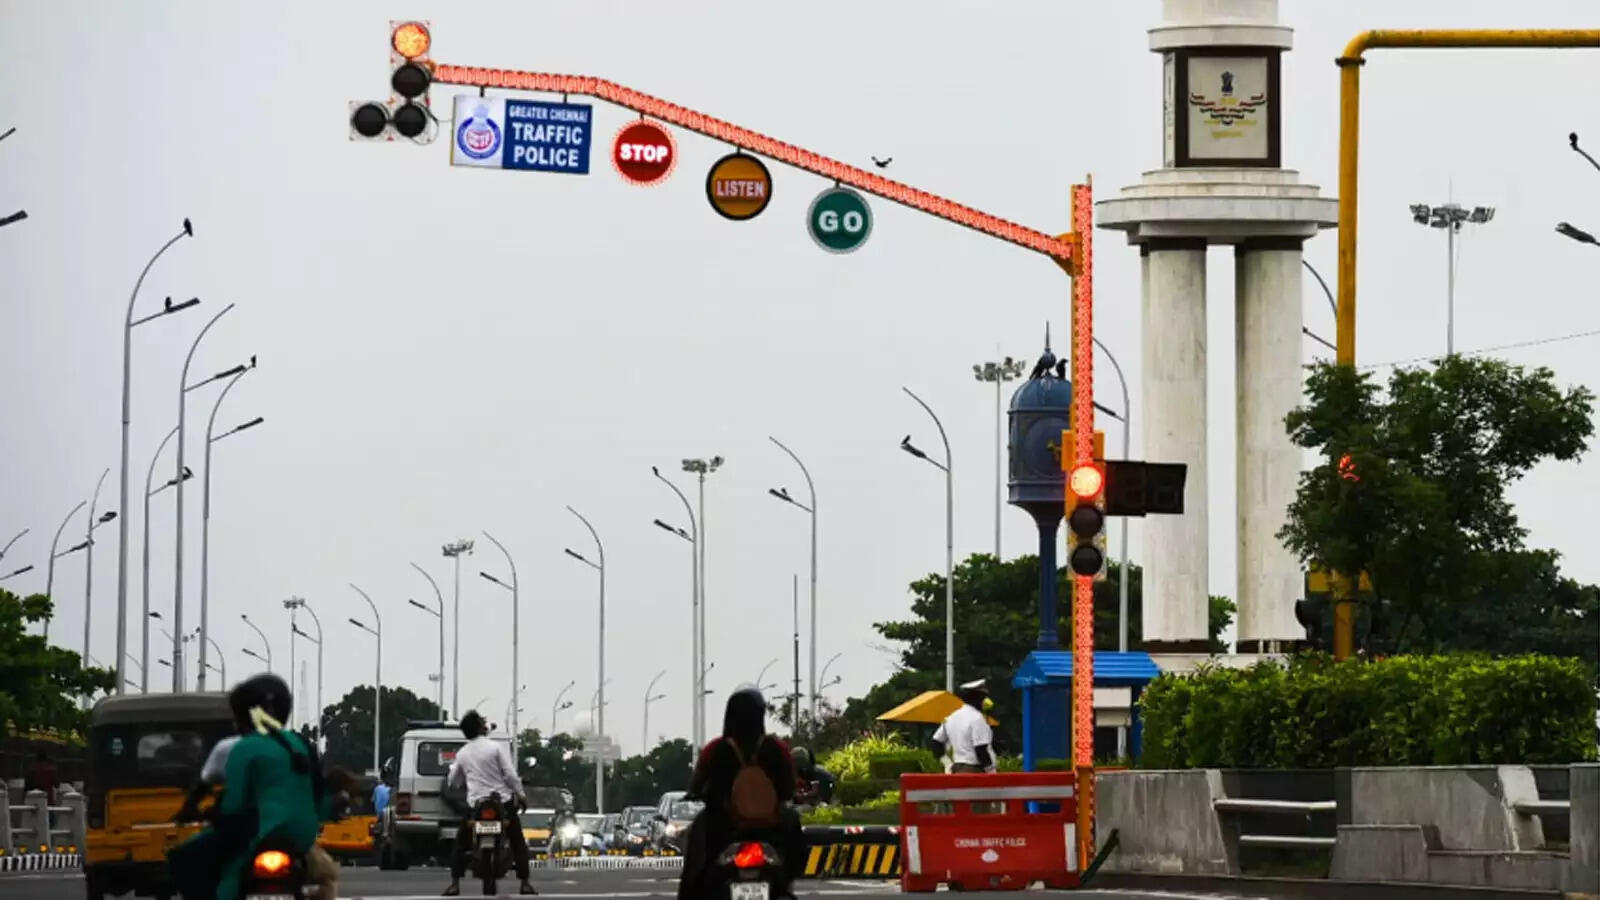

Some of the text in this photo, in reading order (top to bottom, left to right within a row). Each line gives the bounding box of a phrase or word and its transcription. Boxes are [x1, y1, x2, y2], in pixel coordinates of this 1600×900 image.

[509, 105, 548, 120] GREATER
[512, 122, 583, 145] TRAFFIC
[513, 145, 579, 167] POLICE
[620, 143, 669, 162] STOP
[716, 180, 765, 198] LISTEN
[818, 210, 864, 233] GO
